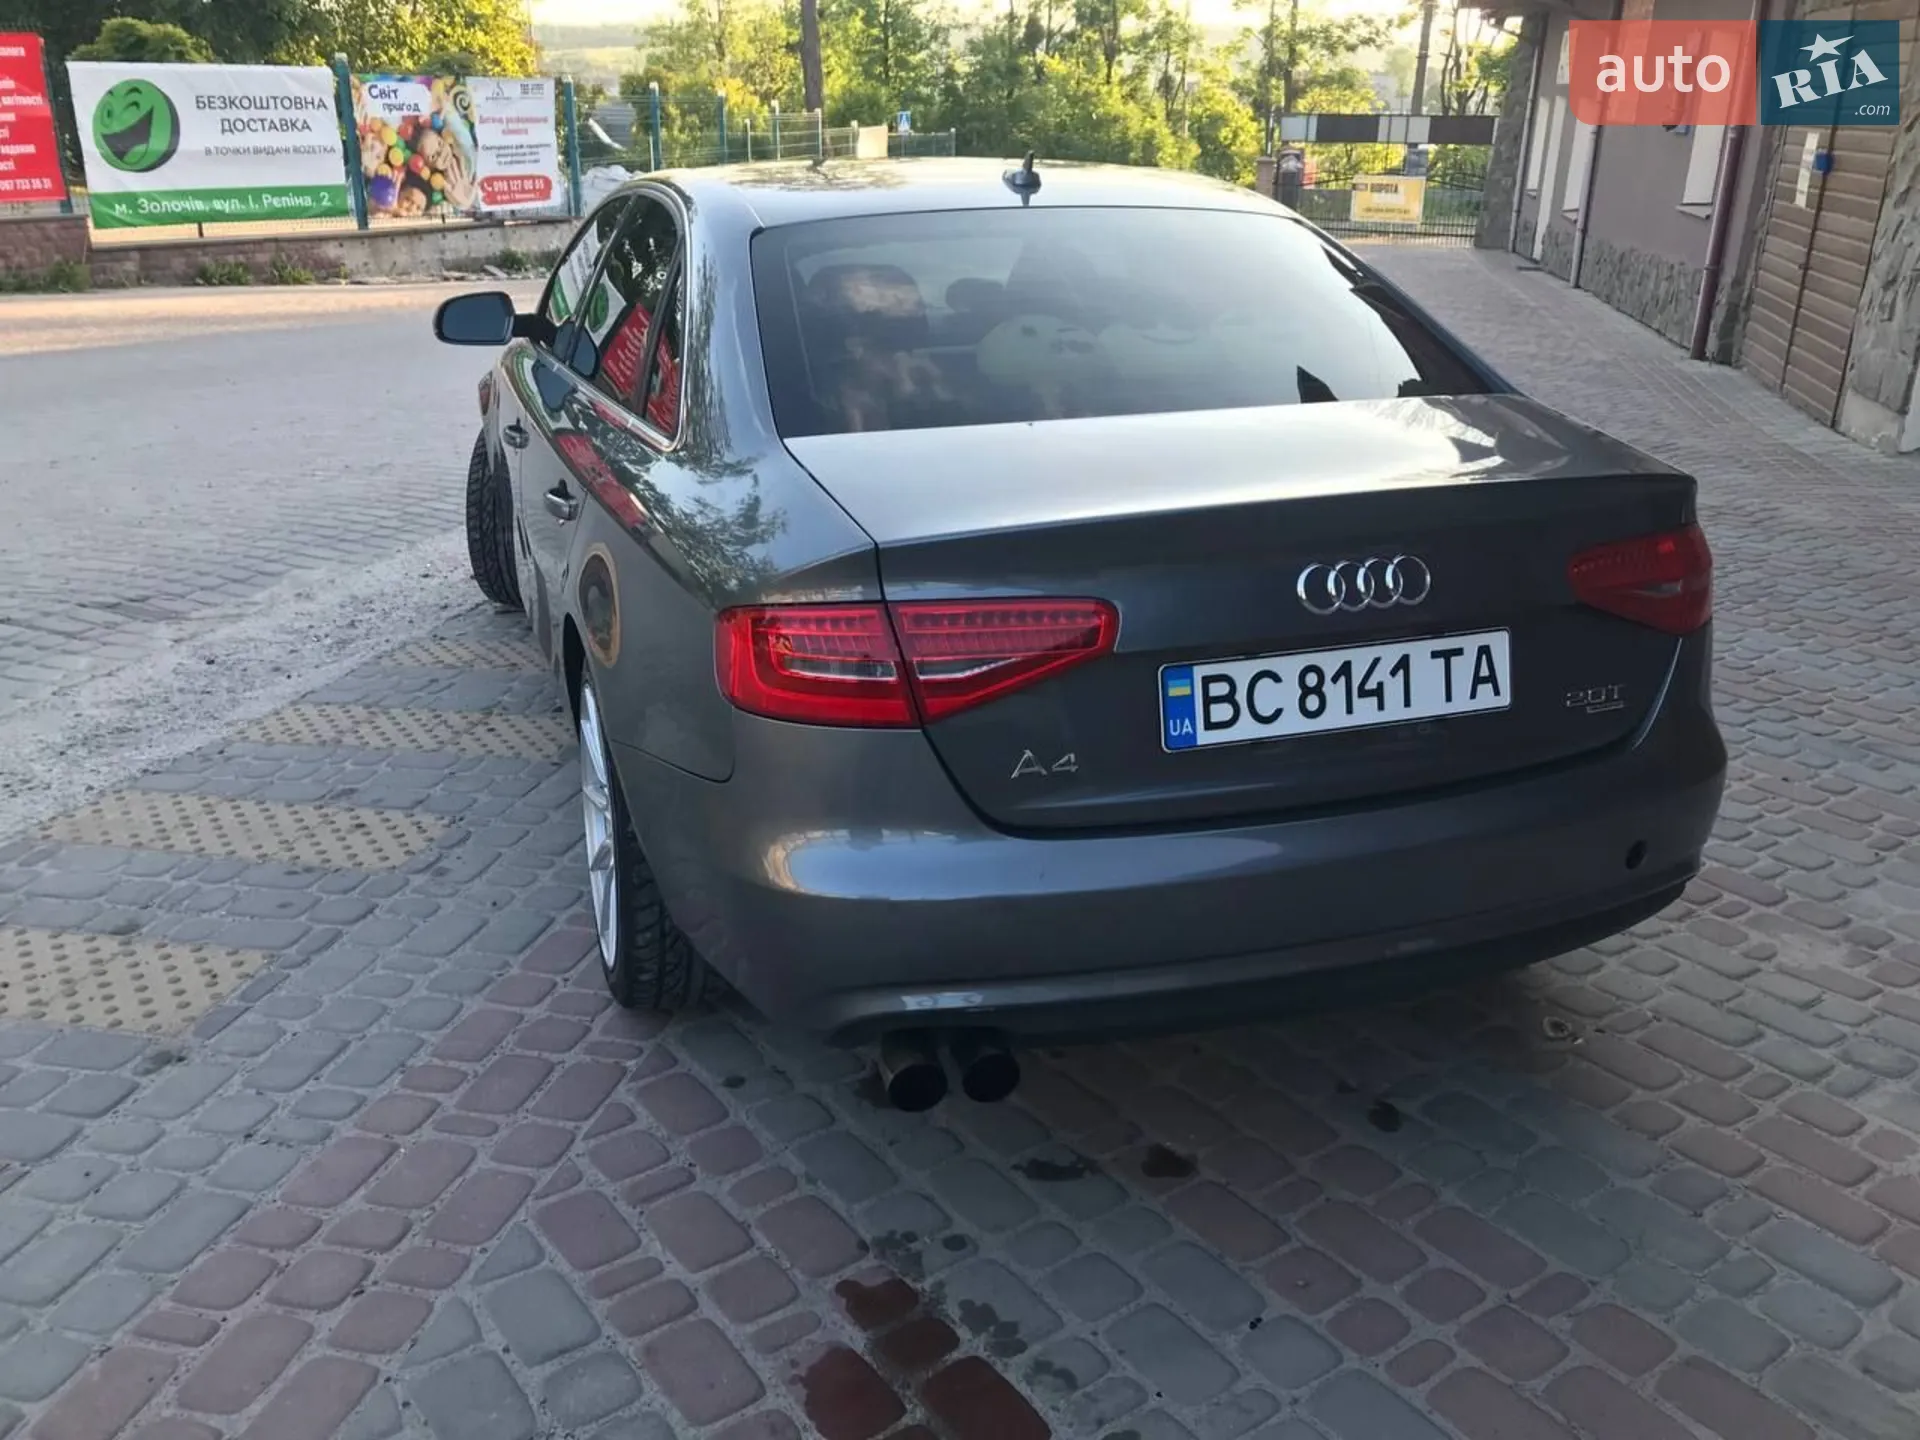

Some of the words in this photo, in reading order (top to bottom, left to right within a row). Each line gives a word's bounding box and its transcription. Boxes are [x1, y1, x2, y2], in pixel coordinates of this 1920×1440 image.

[368, 84, 398, 99] Світ
[195, 95, 328, 110] БЕЗКОШТОВНА
[220, 118, 312, 135] ДОСТАВКА
[214, 145, 251, 157] ТОЧКИ
[320, 191, 332, 206] 2
[1201, 669, 1284, 732] BC
[1298, 653, 1412, 719] 8141
[1431, 644, 1501, 703] TA
[1169, 719, 1194, 737] UA
[1010, 749, 1079, 779] A4
